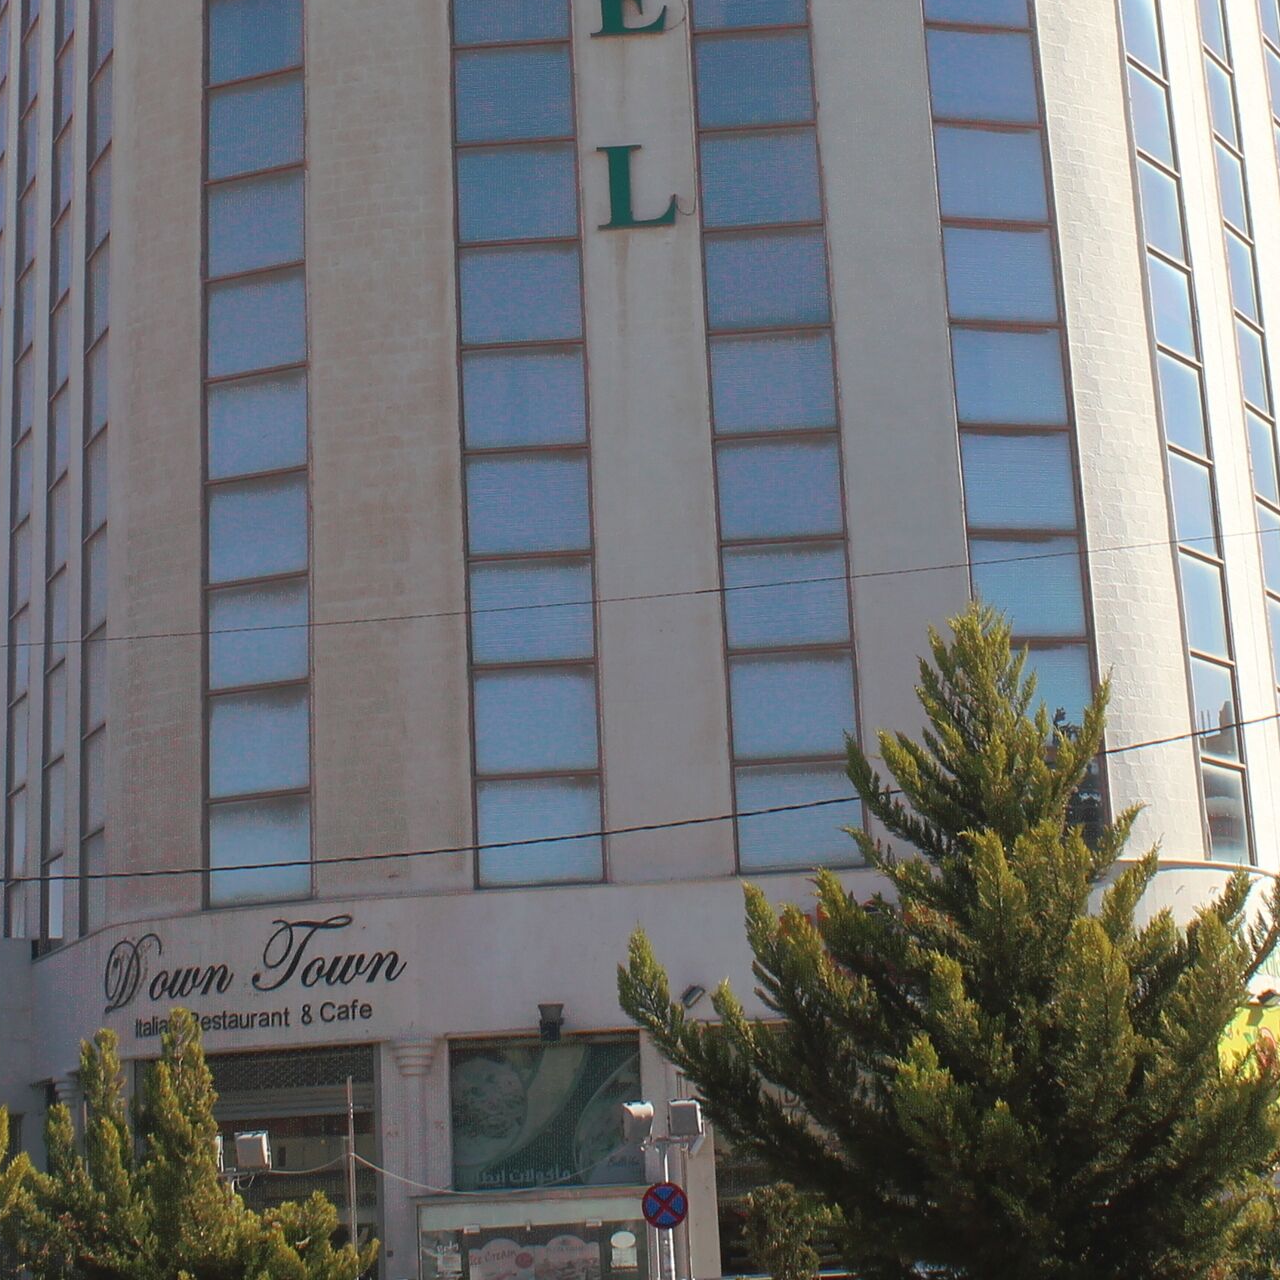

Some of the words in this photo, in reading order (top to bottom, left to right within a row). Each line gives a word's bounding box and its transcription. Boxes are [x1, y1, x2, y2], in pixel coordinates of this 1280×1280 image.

[104, 932, 234, 1014] Down
[251, 914, 408, 992] Town
[135, 1014, 175, 1039] Italia
[301, 1005, 313, 1025] &
[320, 999, 373, 1022] Cafe
